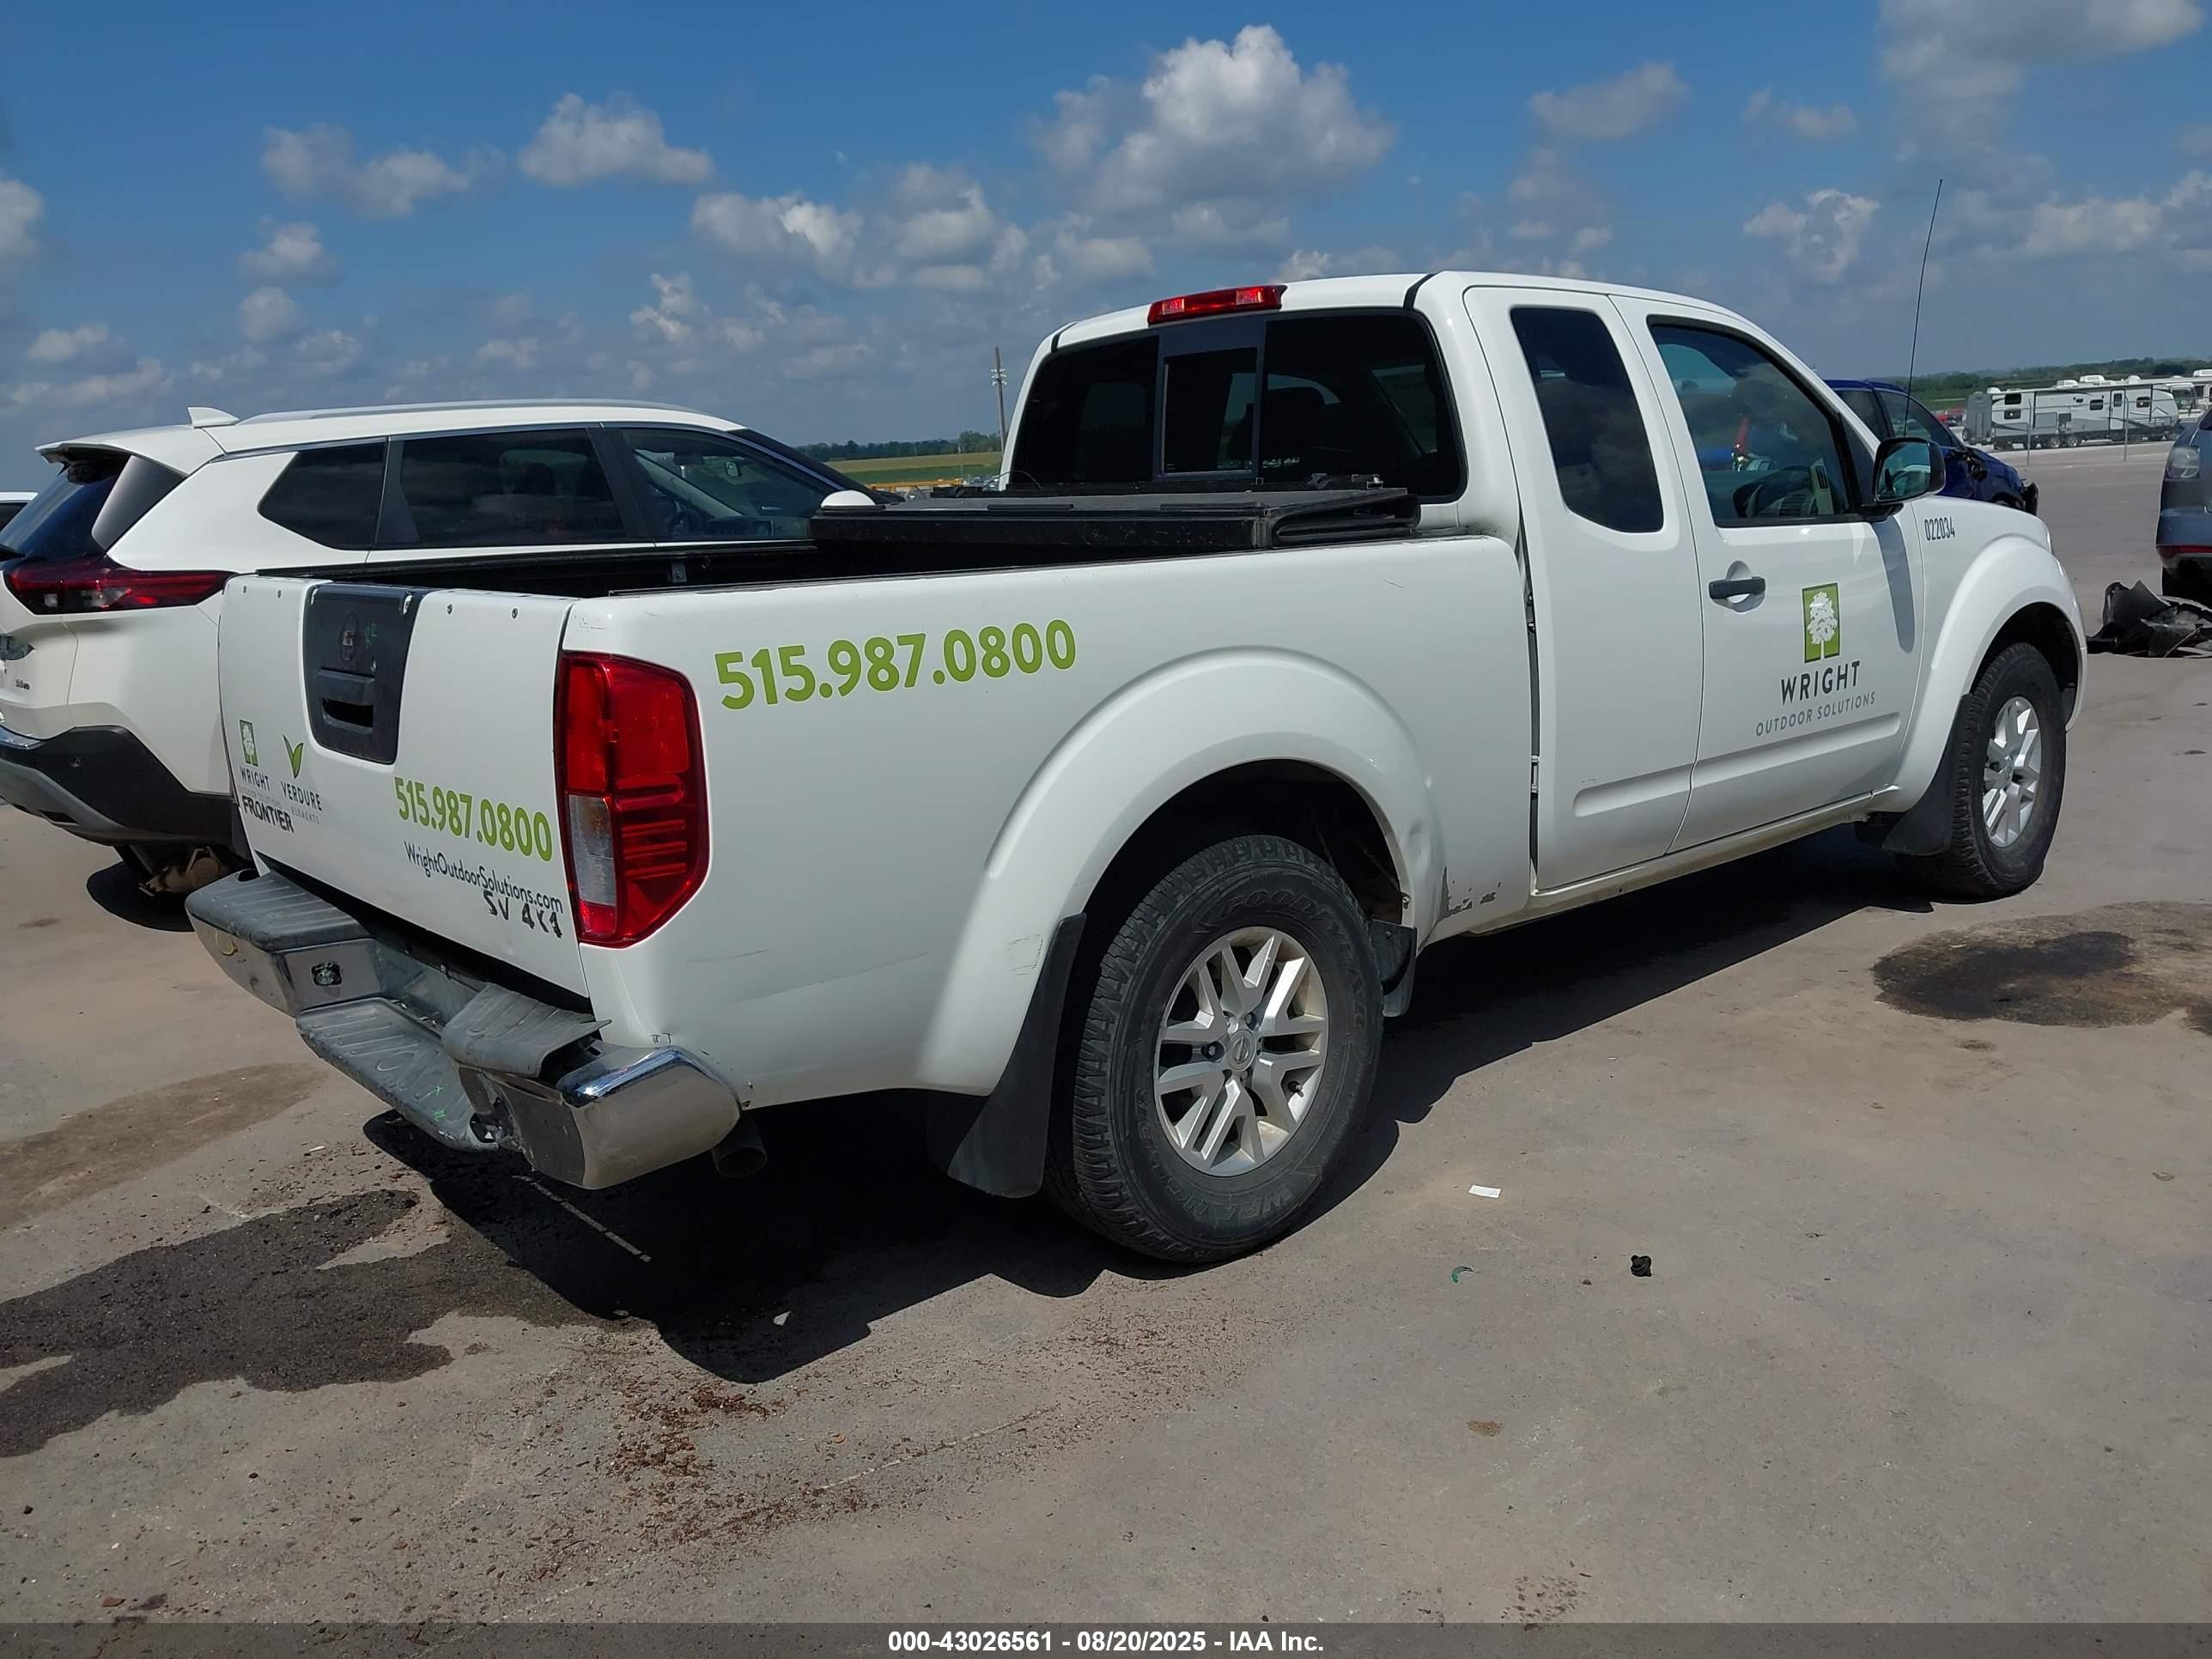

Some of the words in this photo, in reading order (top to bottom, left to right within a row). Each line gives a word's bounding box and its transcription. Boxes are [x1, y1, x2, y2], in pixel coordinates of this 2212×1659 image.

[1924, 516, 1955, 541] 022034
[714, 619, 1076, 710] 515.987.0800
[1781, 660, 1861, 706] WRIGHT
[1756, 708, 1813, 736] OUTDOOR
[1817, 691, 1875, 720] SOLUTIONS
[240, 766, 270, 790] WRIGHT
[281, 781, 322, 811] VERDURE
[241, 794, 294, 833] FRONTIER
[395, 776, 552, 862] 515.987.0800
[404, 841, 564, 914] WrightOutdoorSolutions.com
[483, 890, 509, 921] SV
